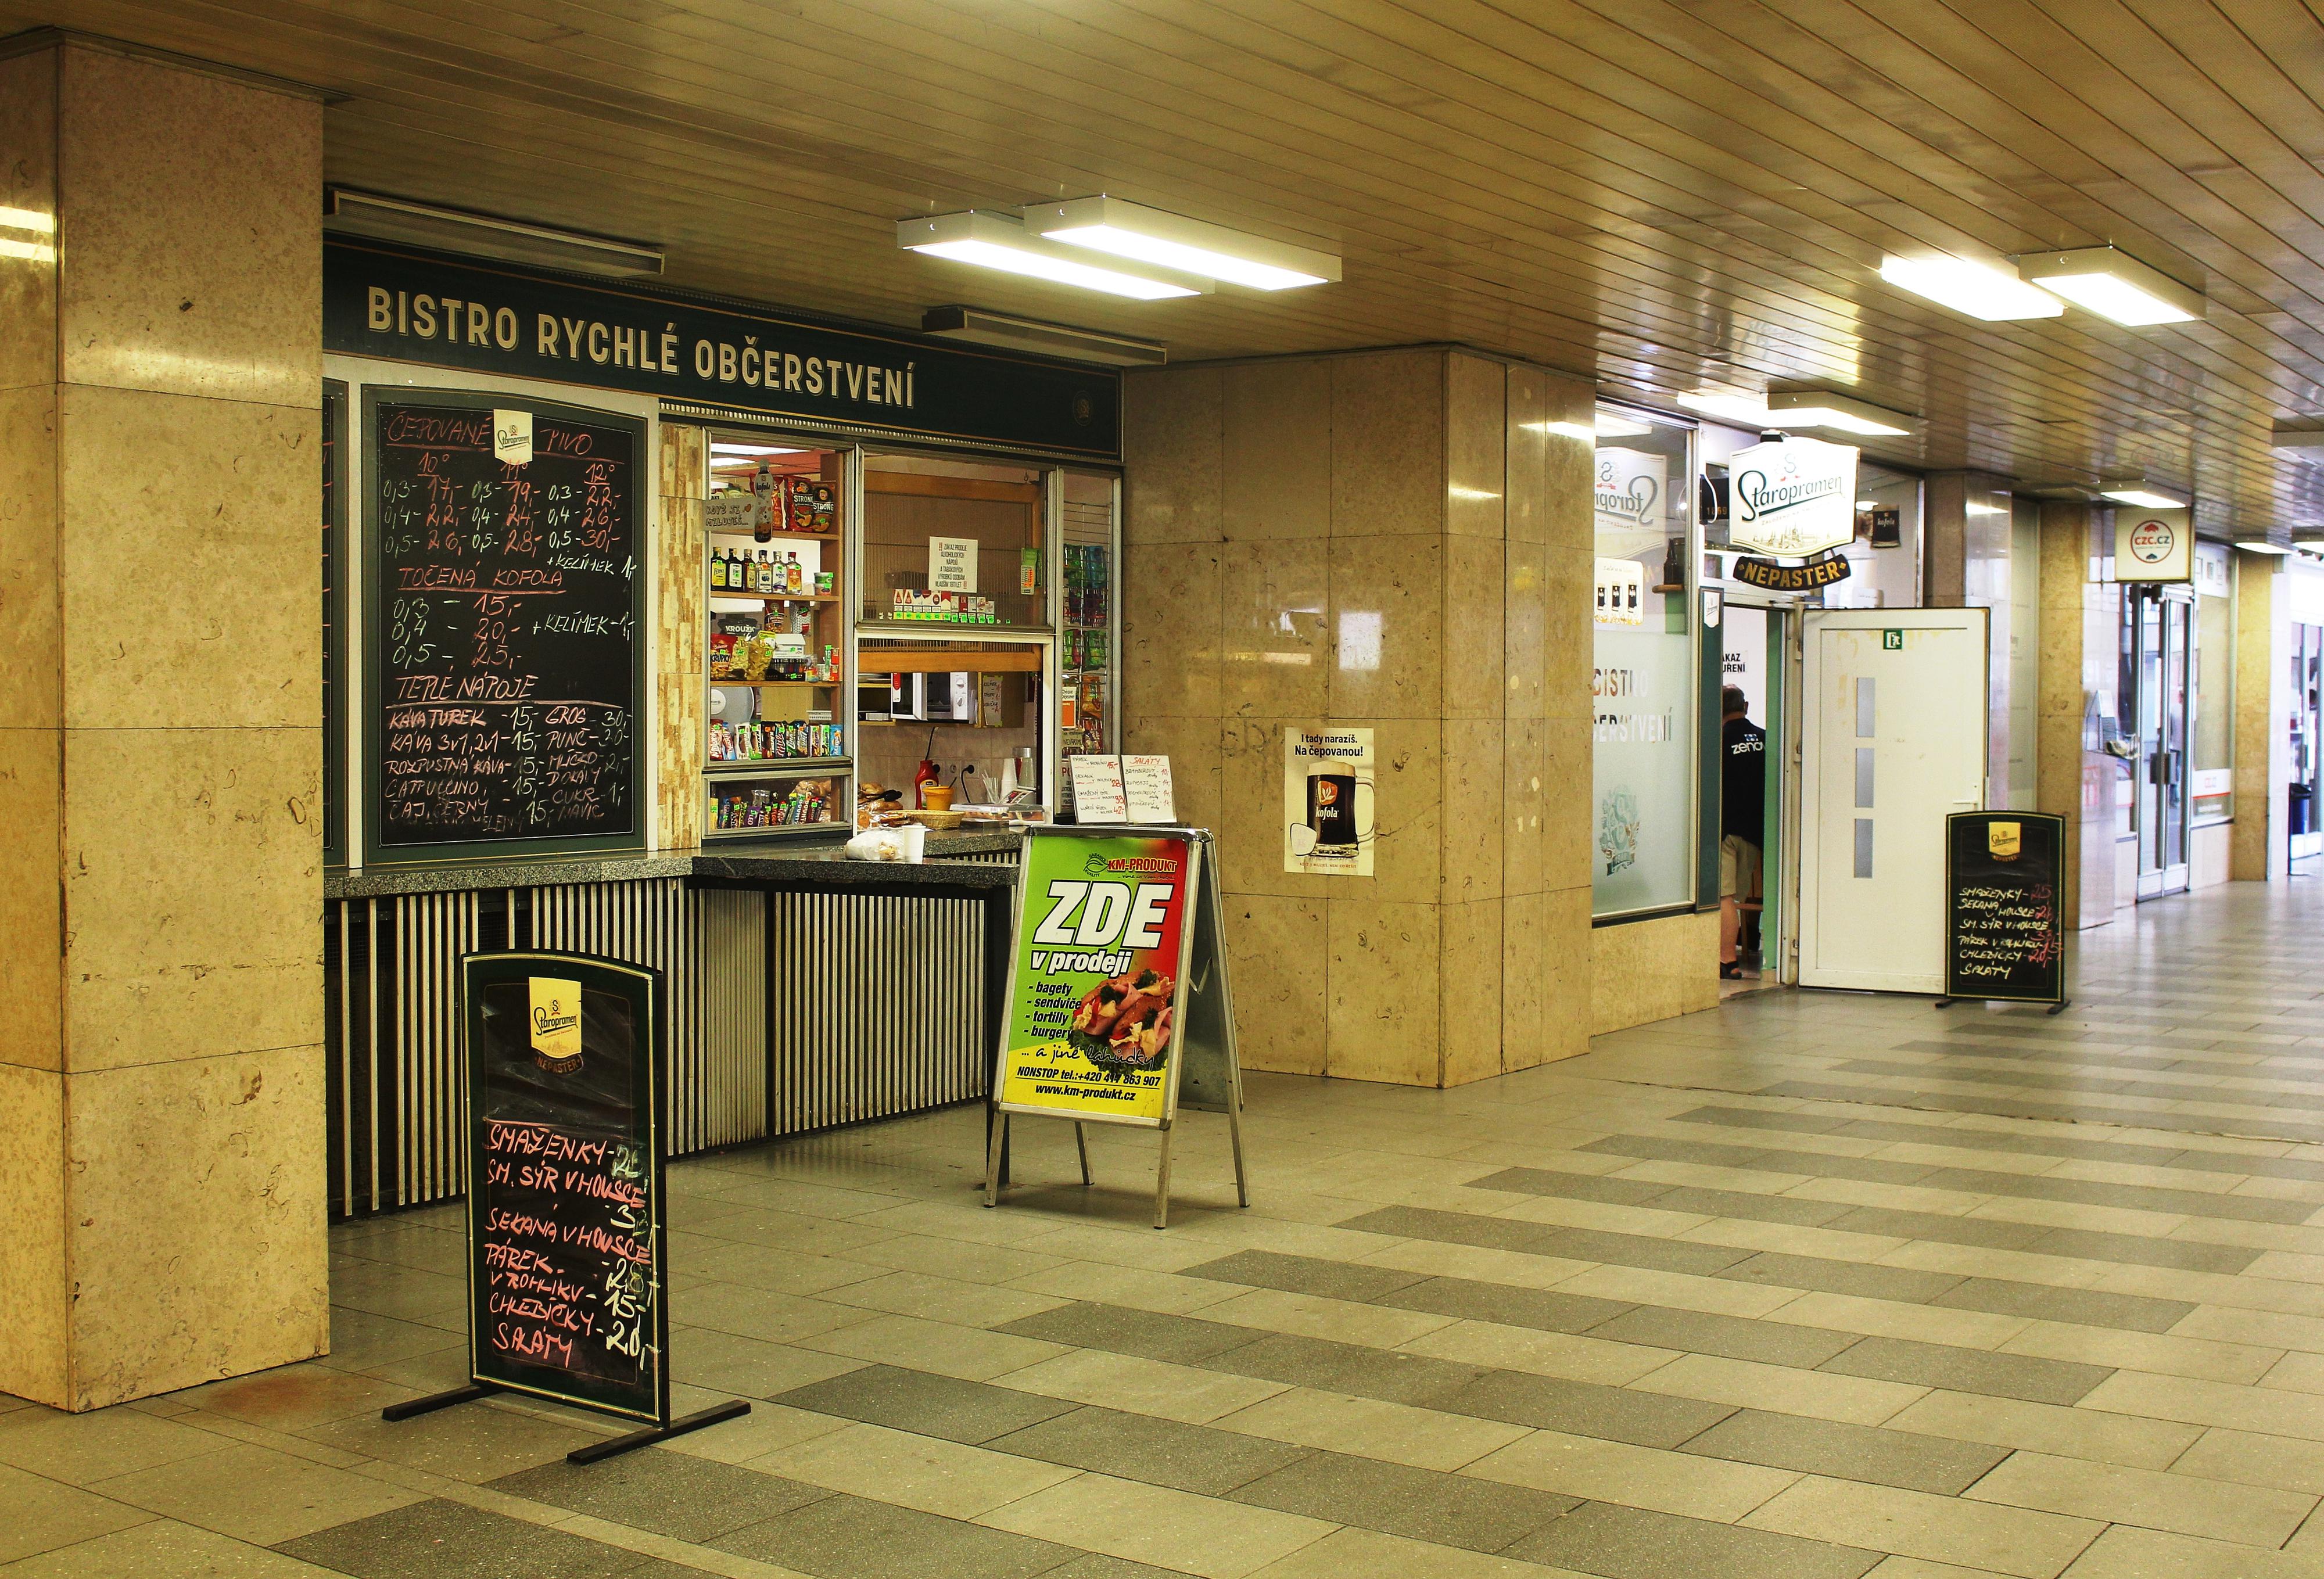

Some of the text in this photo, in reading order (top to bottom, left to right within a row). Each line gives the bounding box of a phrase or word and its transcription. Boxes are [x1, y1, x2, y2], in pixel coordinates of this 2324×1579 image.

[368, 286, 916, 407] BISTRO RYCHLÉ OBČERSTVENÍ
[388, 411, 592, 455] ČEPOVANÉ PIVO
[497, 429, 531, 450] Staropramen
[813, 503, 834, 511] STRONG
[1738, 471, 1846, 522] Staropramen
[2135, 536, 2169, 545] CZC.CZ
[399, 562, 563, 588] TOČENÁ KOFOLA
[1744, 561, 1841, 587] NEPASTER
[396, 665, 539, 701] TEPLÉ NÁPOJE
[546, 706, 586, 724] GROG
[1306, 734, 1324, 745] tady
[1325, 734, 1358, 744] narazíš.
[1295, 745, 1363, 758] Na čepovanou!
[1316, 806, 1339, 820] kofola
[1108, 857, 1178, 873] KM-PRODUKT
[1031, 880, 1175, 950] ZDE
[1031, 950, 1134, 979] v prodeji
[1035, 981, 1073, 996] bagety
[1034, 996, 1082, 1010] sendviče
[534, 1007, 579, 1036] Staropramen
[1032, 1010, 1069, 1025] tortilly
[1036, 1044, 1155, 1071] a jiné lahůdky
[1017, 1066, 1059, 1079] NONSTOP
[1123, 1074, 1141, 1086] 863
[1143, 1076, 1161, 1087] 907
[1035, 1085, 1136, 1101] www.km-produkt.cz
[520, 1159, 558, 1193] SÝR
[493, 1323, 572, 1369] SALÁTY
